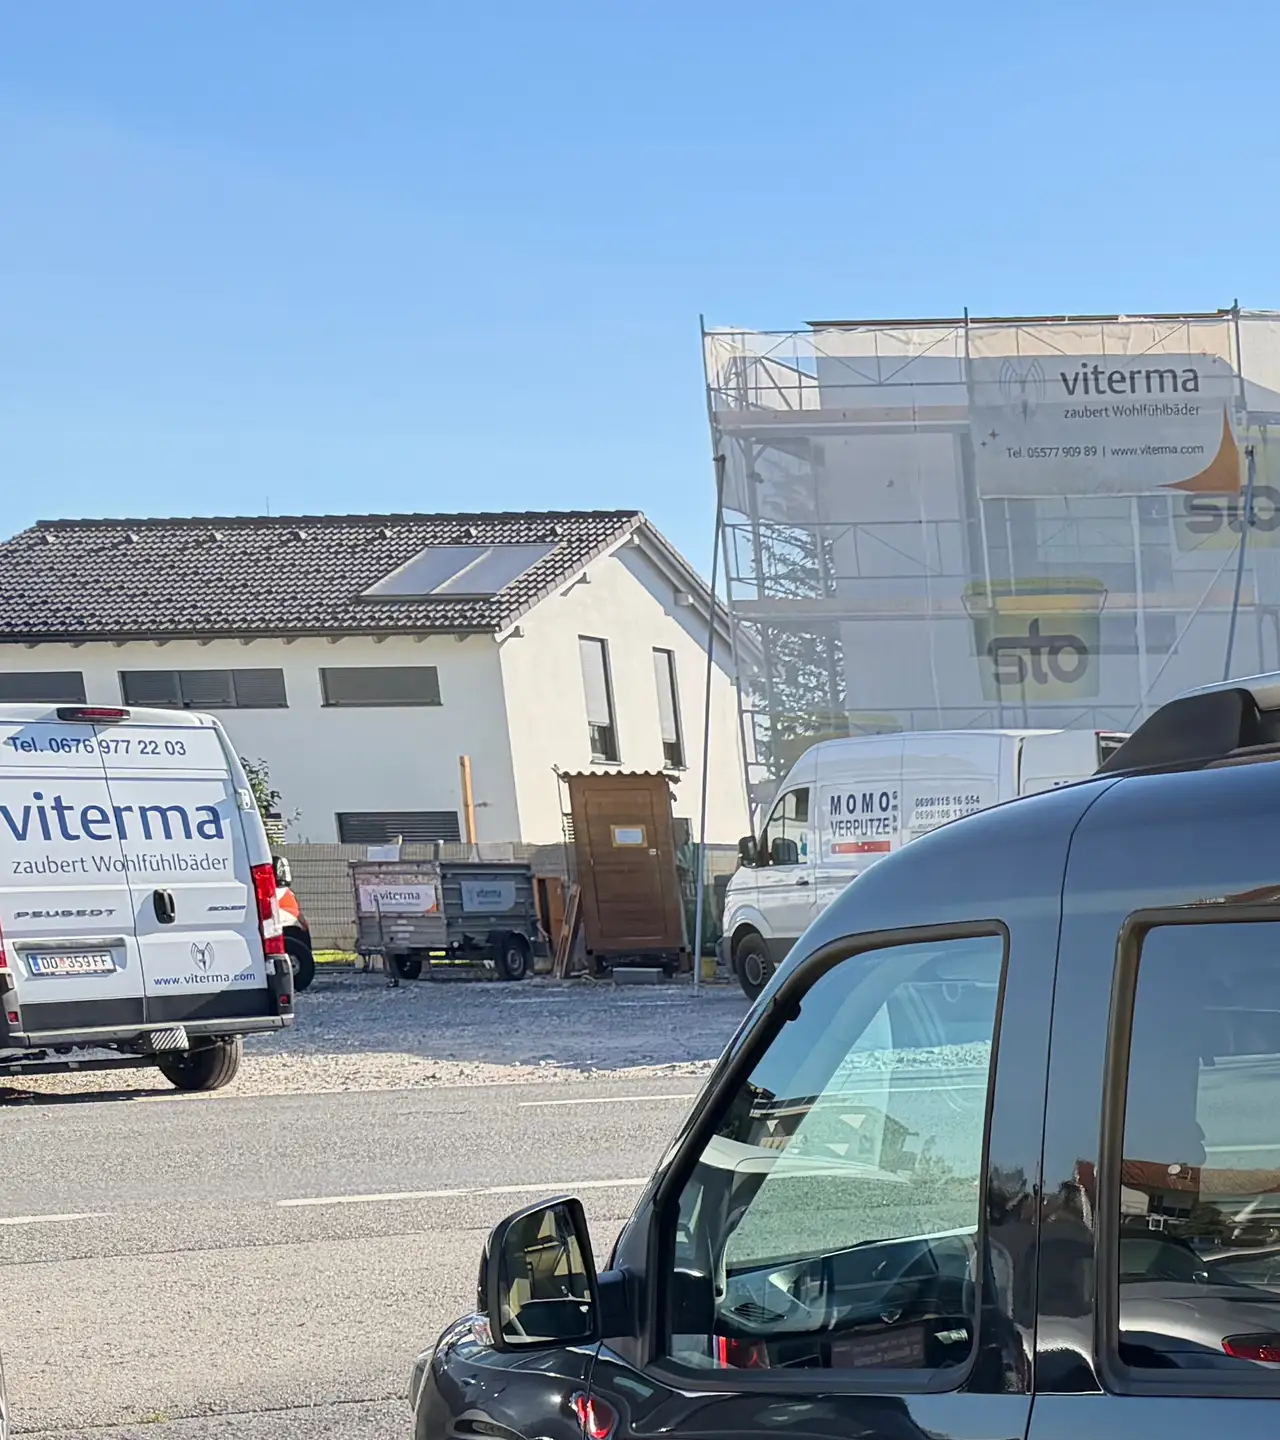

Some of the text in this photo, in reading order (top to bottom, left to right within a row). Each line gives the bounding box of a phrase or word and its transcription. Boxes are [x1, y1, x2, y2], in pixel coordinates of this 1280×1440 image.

[1060, 362, 1200, 396] viterma
[1063, 402, 1200, 419] zaubert Wohlfühlbäder
[1006, 446, 1026, 458] Tel.
[1027, 446, 1060, 458] 05577
[1062, 446, 1082, 458] 909
[1084, 446, 1098, 457] 89
[1111, 444, 1204, 457] www.viterma.com
[987, 617, 1090, 686] sto
[8, 736, 187, 756] Tel. 0676 977 22 03
[830, 791, 891, 816] MOMO
[0, 791, 225, 841] viterma
[830, 817, 891, 837] VERPUTZE
[12, 853, 229, 874] zaubert Wohlfühlbäder
[380, 889, 420, 901] viterma
[14, 908, 117, 920] PEUGEOT
[153, 971, 256, 987] www.viterma.com
